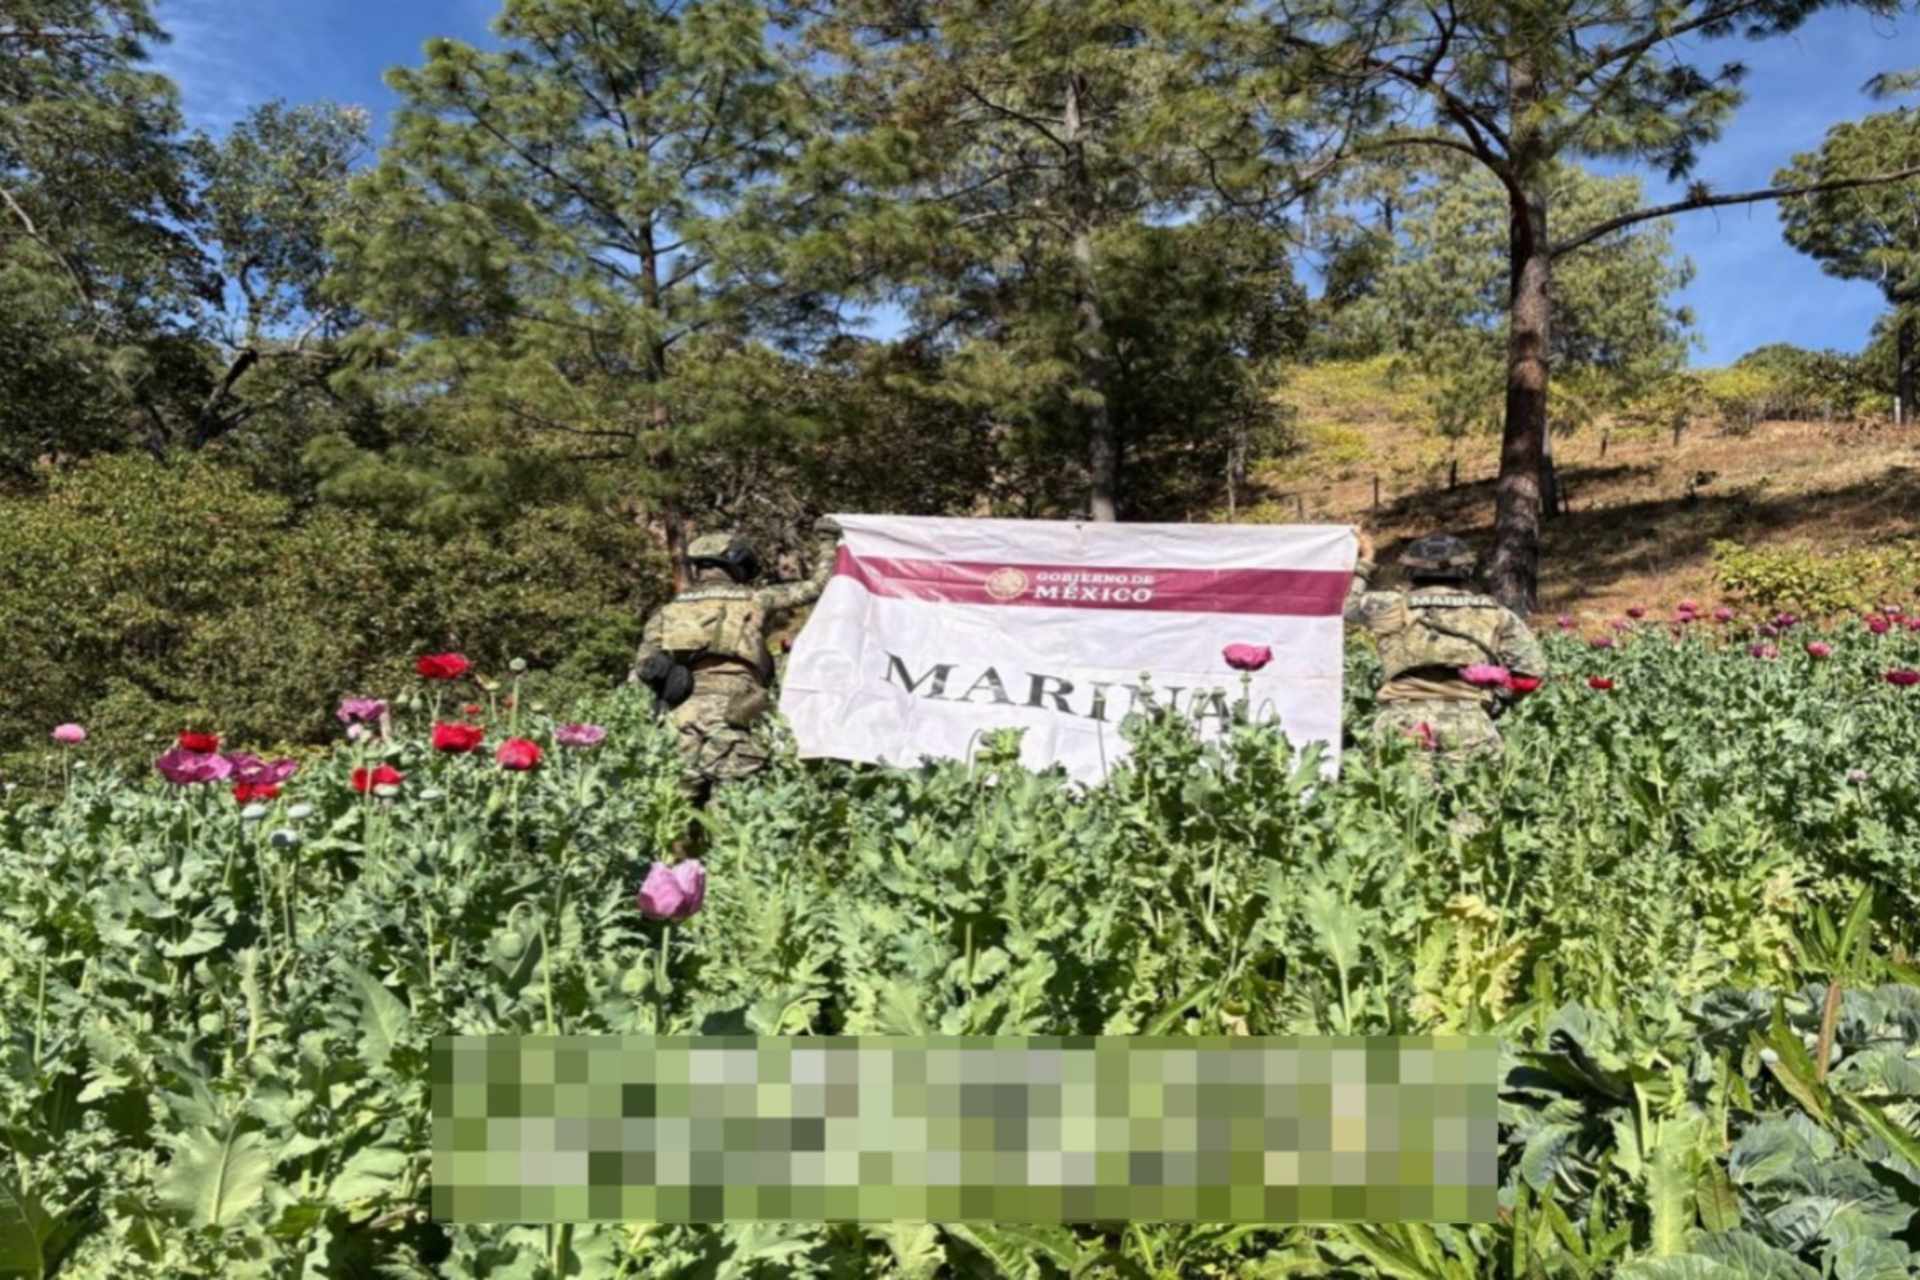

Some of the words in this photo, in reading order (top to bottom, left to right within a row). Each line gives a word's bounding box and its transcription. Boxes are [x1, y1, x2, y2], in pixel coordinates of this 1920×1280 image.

[1035, 571, 1128, 584] GOBIERNO
[1130, 573, 1155, 585] DE
[1034, 582, 1153, 603] MÉXICO
